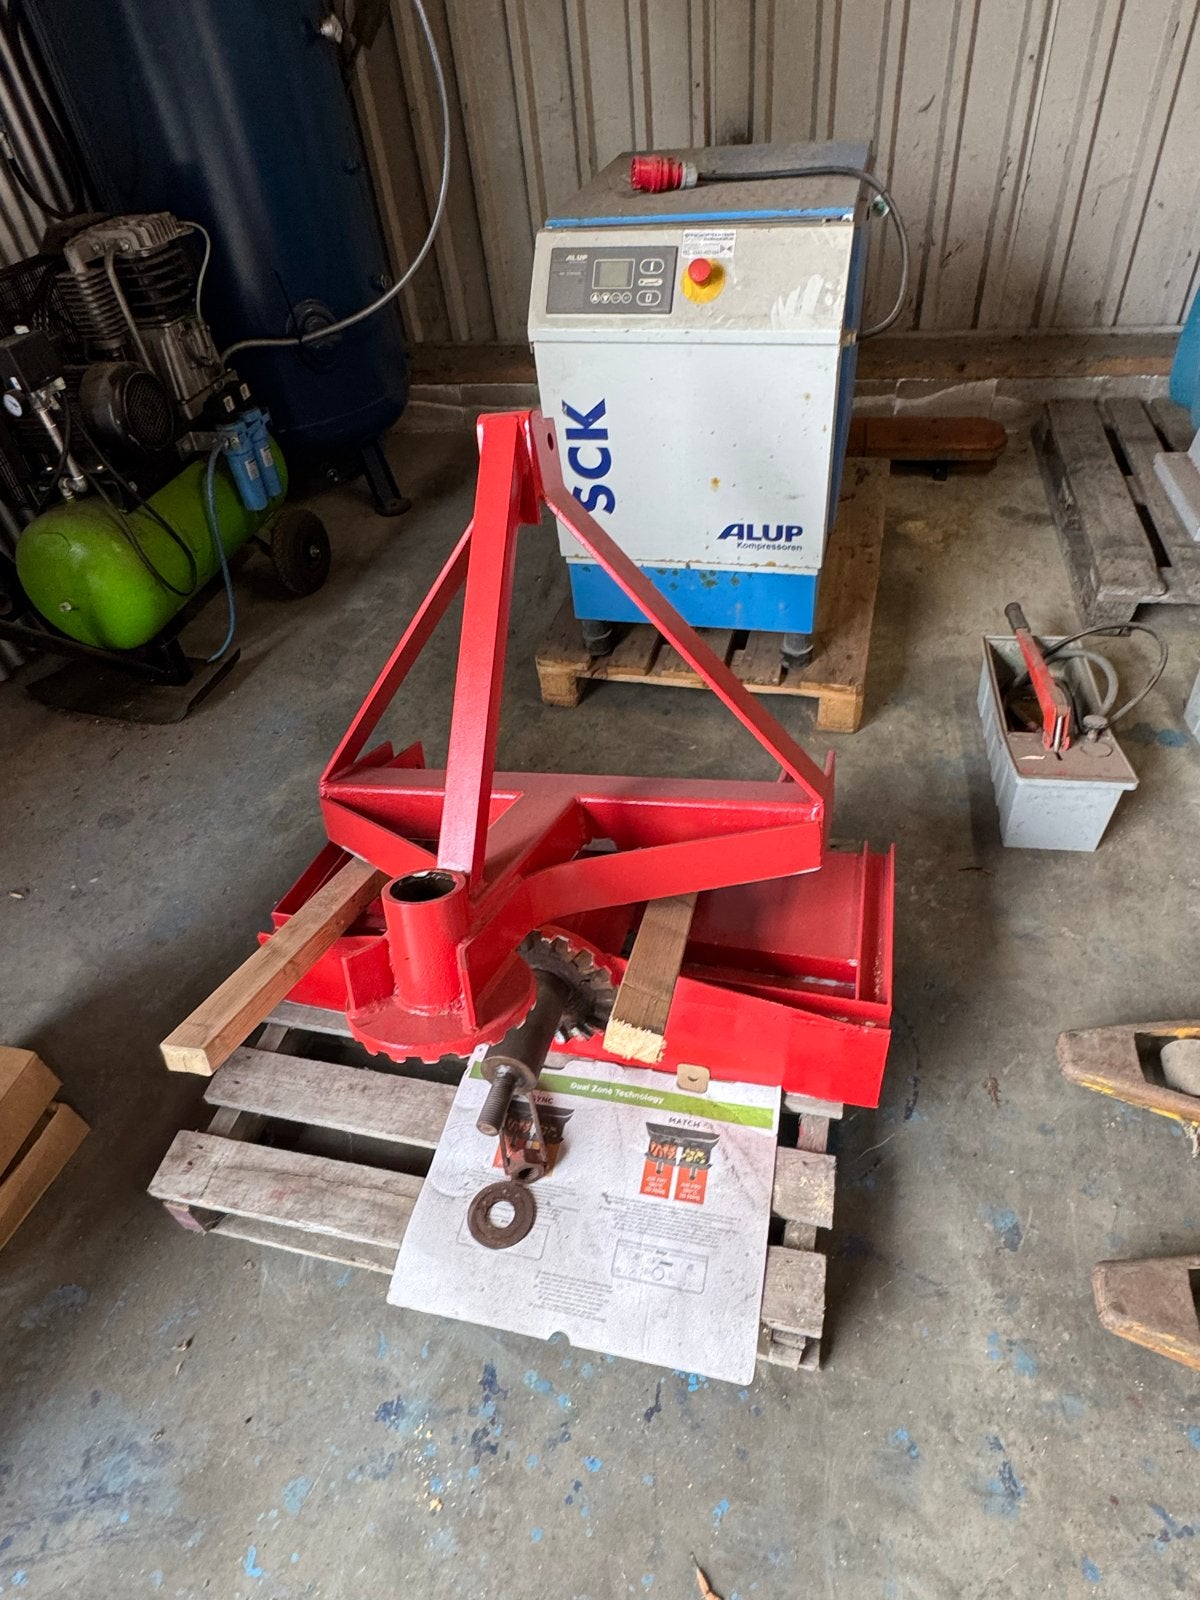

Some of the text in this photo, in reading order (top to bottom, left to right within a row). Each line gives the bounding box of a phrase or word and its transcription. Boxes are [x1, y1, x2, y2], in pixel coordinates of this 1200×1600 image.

[566, 254, 588, 262] ALUP
[561, 398, 616, 515] SCK
[717, 523, 803, 543] ALUP
[736, 541, 803, 552] Kompressoren
[570, 1081, 665, 1105] Dual Zone Technology
[668, 1116, 701, 1128] MATCH
